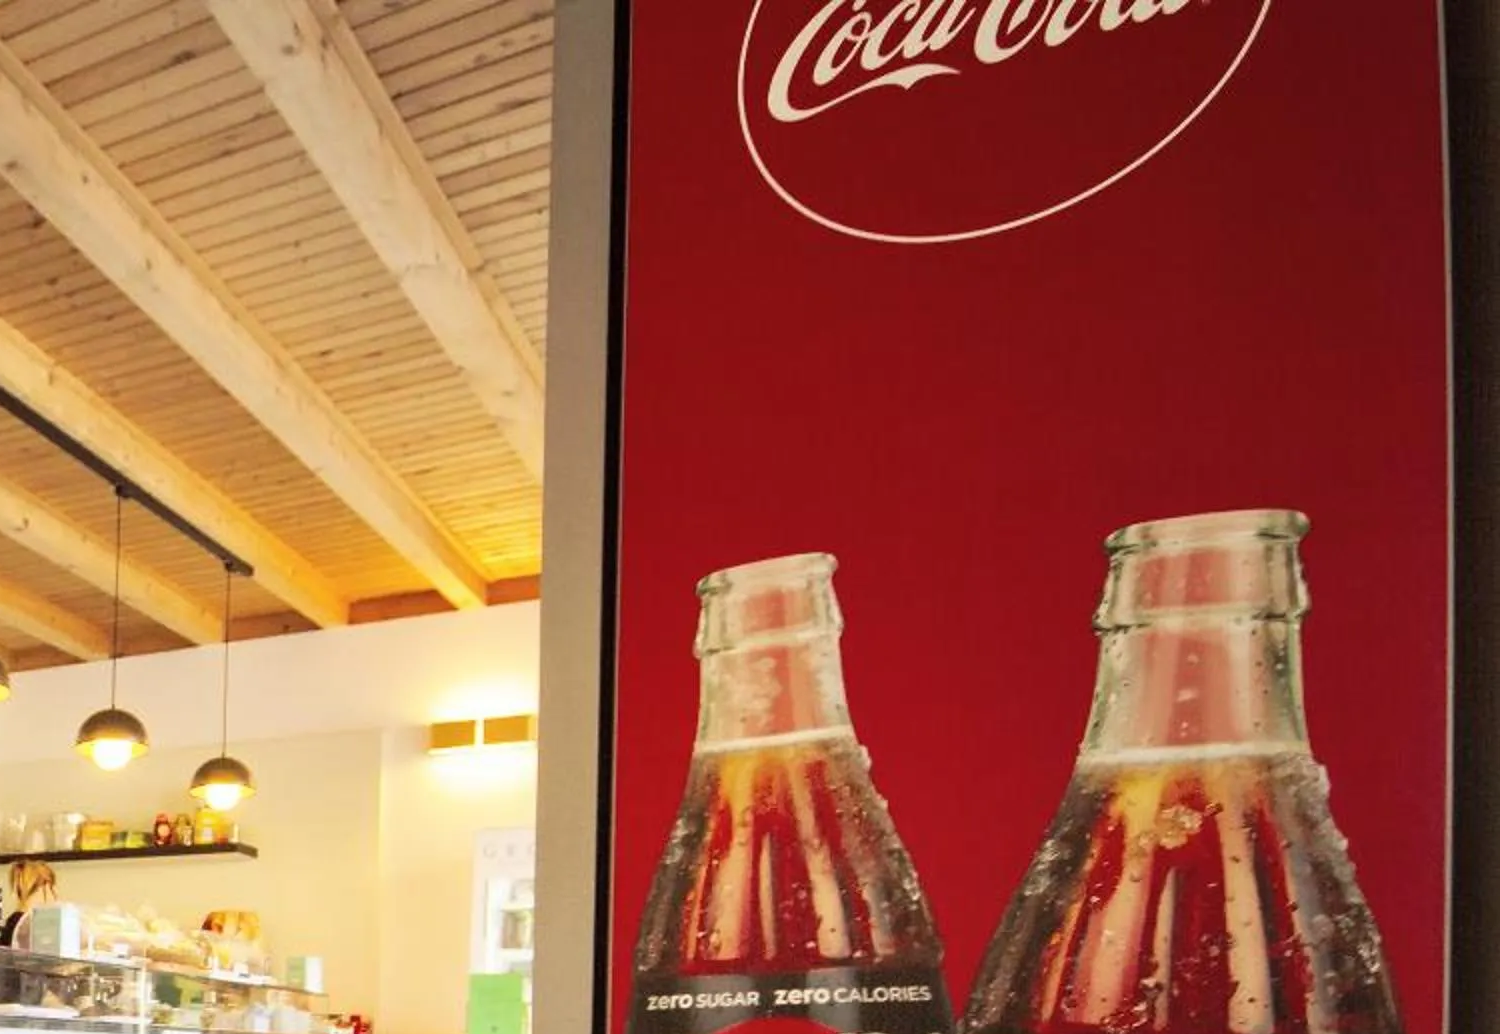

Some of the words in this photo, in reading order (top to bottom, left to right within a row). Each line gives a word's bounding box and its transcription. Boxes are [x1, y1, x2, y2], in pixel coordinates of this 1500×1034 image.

[767, 0, 1190, 122] CocaCo
[646, 990, 694, 1011] zero
[695, 989, 760, 1009] SUGAR
[774, 986, 831, 1007] zero
[833, 984, 932, 1005] CALORIES
